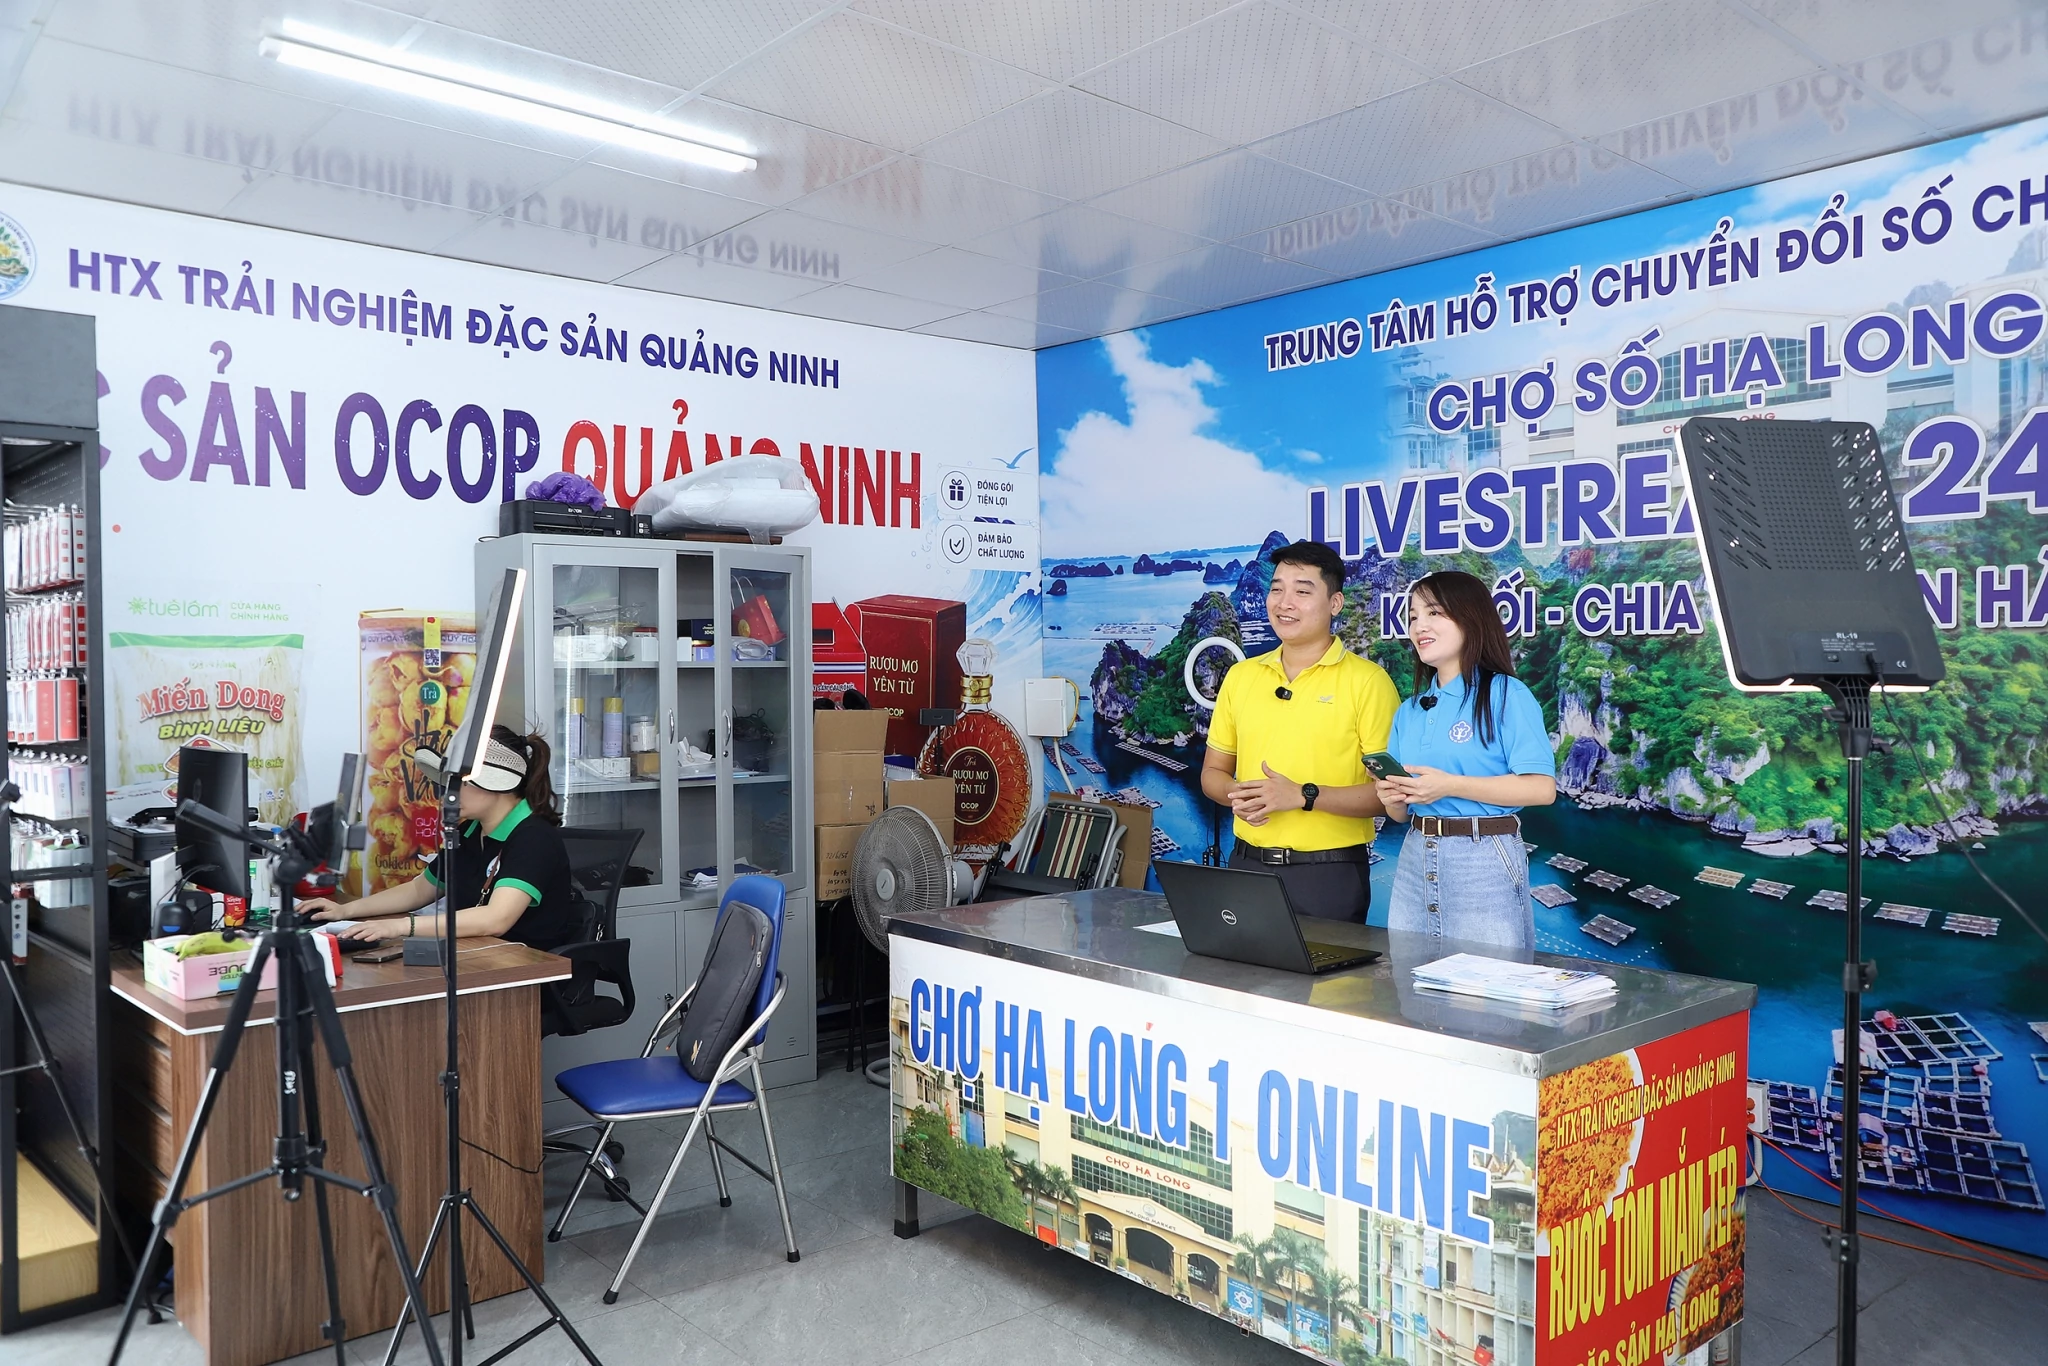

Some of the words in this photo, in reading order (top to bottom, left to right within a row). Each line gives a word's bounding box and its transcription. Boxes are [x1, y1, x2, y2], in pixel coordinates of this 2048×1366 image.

[1265, 319, 1361, 370] TRUNG
[1367, 301, 1434, 349] TÂM
[1446, 276, 1497, 337] HỖ
[1508, 269, 1578, 326] TRỢ
[1591, 219, 1759, 308] CHUYỂN
[1776, 193, 1863, 273] ĐỔI
[1882, 174, 1953, 252] SỐ
[69, 248, 163, 300] HTX
[178, 260, 275, 317] TRẢI
[292, 288, 452, 347] NGHIỆM
[466, 304, 548, 359] ĐẶC
[560, 312, 628, 363] SẢN
[640, 329, 759, 379] QUẢNG
[769, 351, 839, 389] NINH
[1429, 362, 1555, 434] CHỢ
[1575, 329, 1662, 413] SỐ
[1683, 335, 1783, 406] HẠ
[1809, 293, 2044, 381] LONG
[139, 340, 306, 490] SẢN
[334, 391, 541, 504] OCOP
[561, 399, 783, 510] QUẢ
[800, 441, 923, 530] NINH
[977, 480, 999, 491] ĐÓNG
[1000, 482, 1014, 493] GÓI
[977, 494, 994, 507] TIỆN
[995, 497, 1008, 508] LỢI
[1308, 453, 1697, 557] LIVESTRE
[977, 531, 996, 544] ĐẢM
[997, 533, 1012, 545] BẢO
[977, 545, 998, 558] CHẤT
[999, 548, 1026, 561] LƯỢNG
[1575, 584, 1699, 634] CHIA
[870, 655, 899, 674] RƯỢU
[901, 659, 919, 674] MƠ
[872, 675, 896, 693] YÊN
[137, 677, 209, 723] Miến
[216, 679, 286, 722] Dong
[421, 686, 438, 700] Trà
[158, 719, 214, 740] BÌNH
[216, 716, 265, 735] LIÊU
[953, 769, 974, 782] RƯỢU
[975, 770, 990, 781] MƠ
[955, 781, 972, 794] YÊN
[375, 853, 411, 870] Golden
[910, 977, 983, 1100] CHỢ
[994, 999, 1050, 1122] HẠ
[1064, 1017, 1188, 1148] LONG
[1208, 1058, 1229, 1161] 1
[1257, 1069, 1491, 1246] ONLINE
[1556, 1109, 1579, 1150] HTX
[1579, 1089, 1602, 1139] TRẢI
[1603, 1080, 1641, 1132] NGHIỆM
[1643, 1076, 1664, 1121] ĐẶC
[1665, 1063, 1683, 1106] SẢN
[1684, 1053, 1715, 1099] QUẢNG
[1715, 1051, 1737, 1087] NINH
[1105, 1155, 1130, 1169] CHỢ
[1156, 1171, 1191, 1190] LONG
[1549, 1168, 1607, 1341] RUỐC
[1612, 1168, 1654, 1307] TÔM
[1660, 1127, 1704, 1281] MẮM
[1708, 1127, 1738, 1252] TÉP
[1655, 1308, 1677, 1356] HẠ
[1681, 1283, 1720, 1338] LONG
